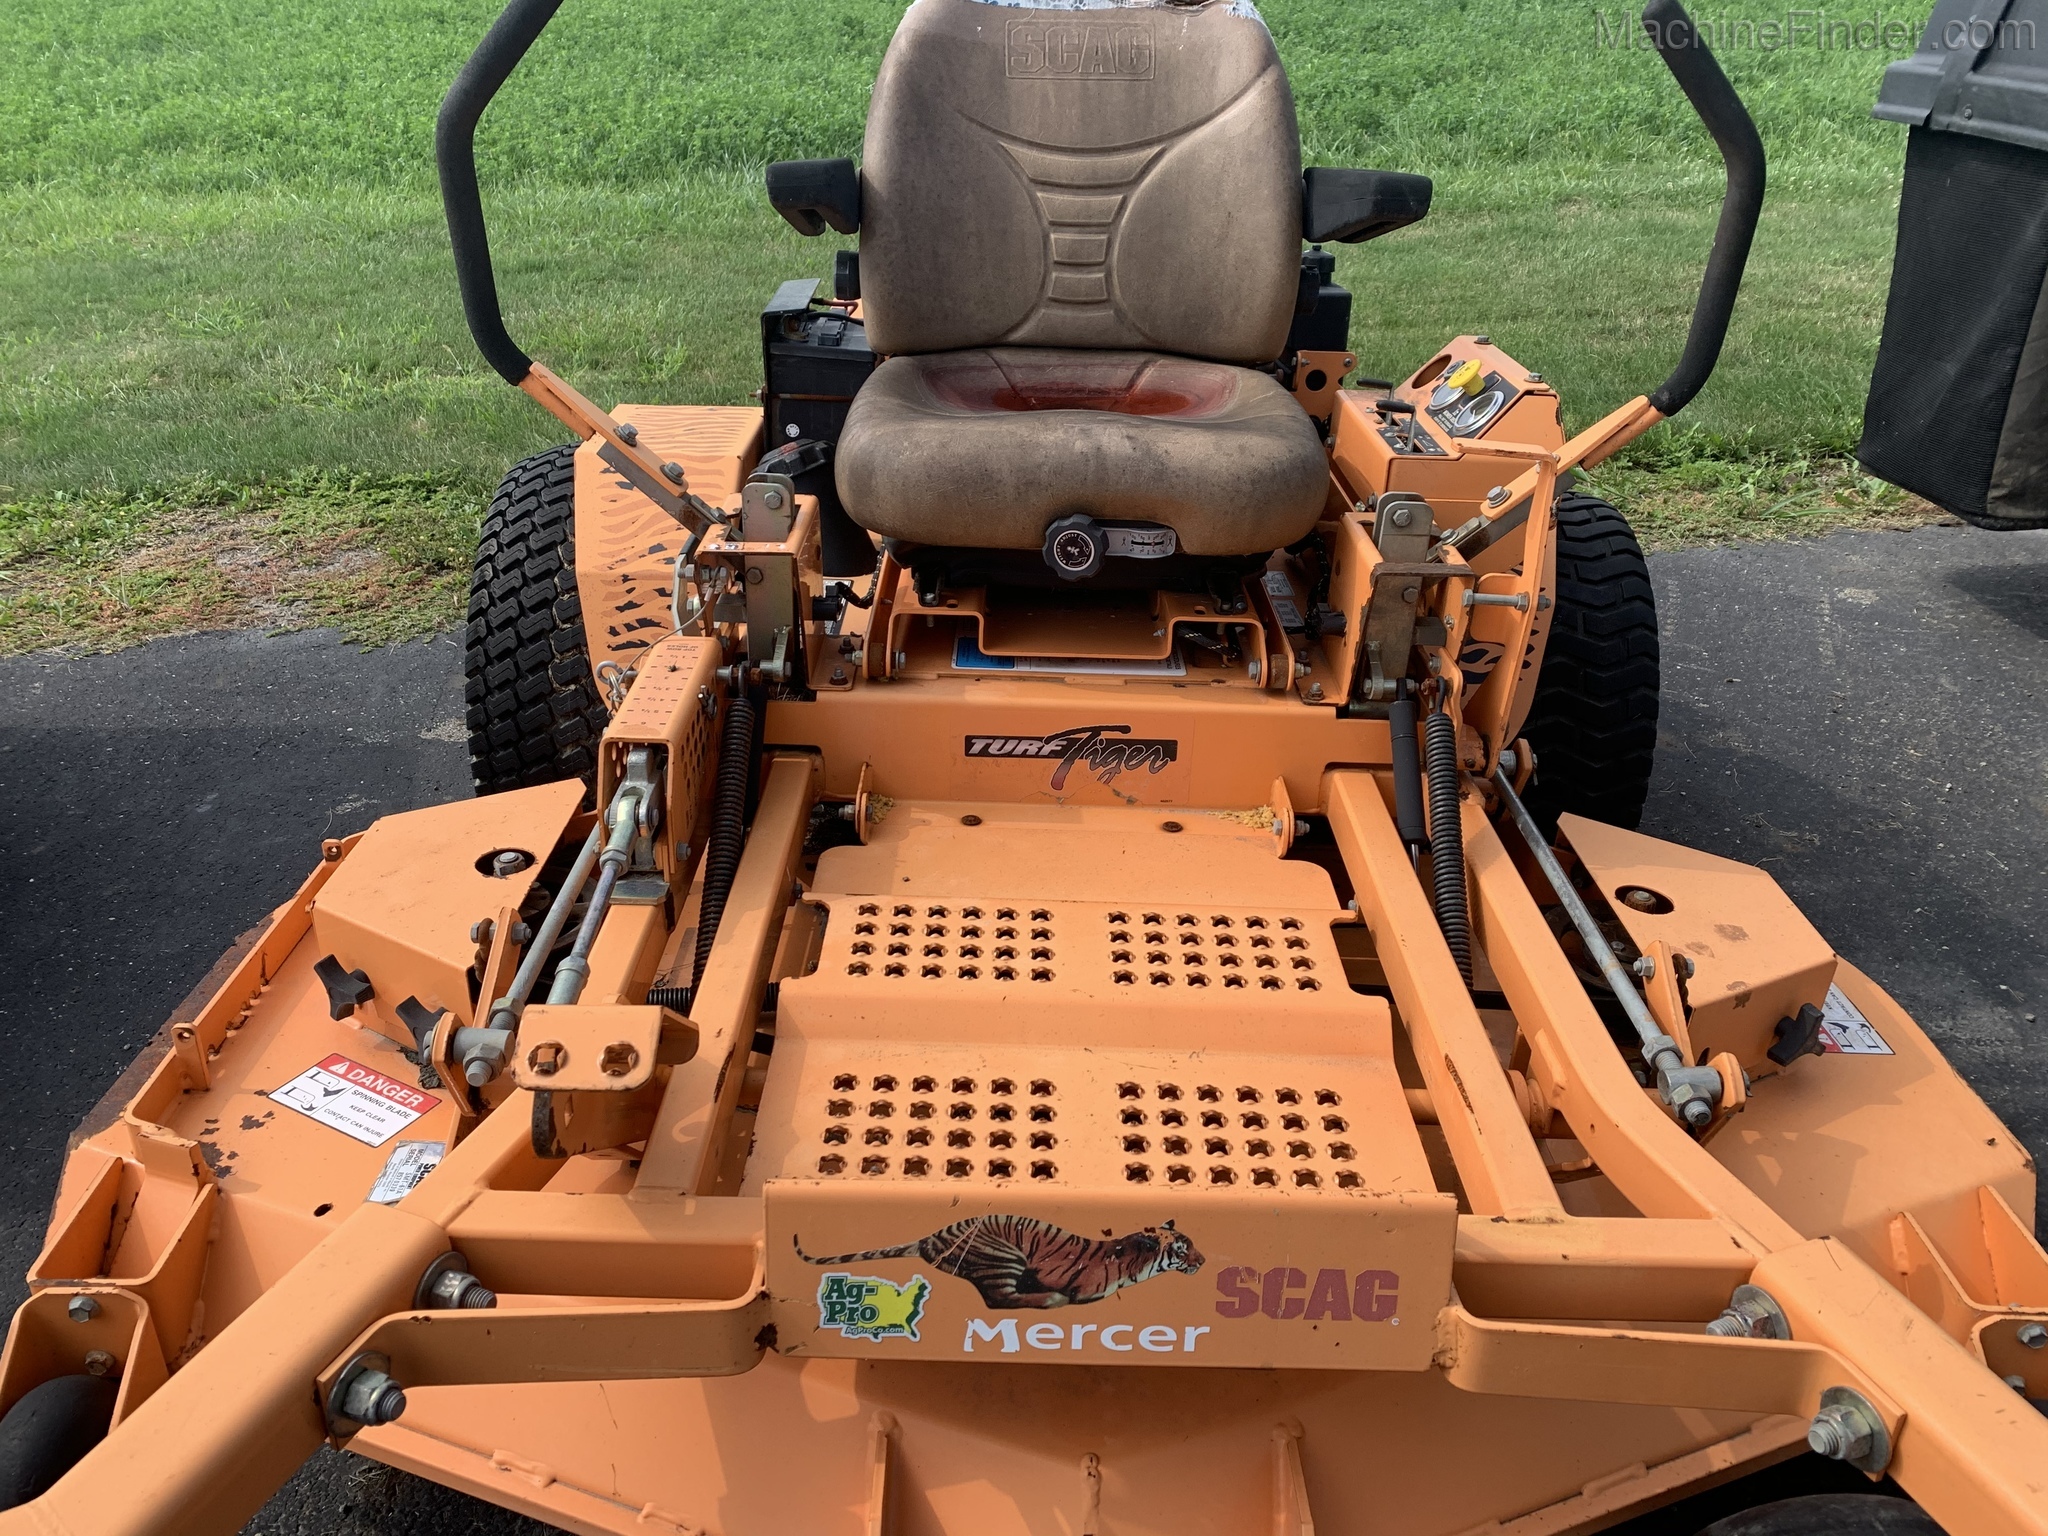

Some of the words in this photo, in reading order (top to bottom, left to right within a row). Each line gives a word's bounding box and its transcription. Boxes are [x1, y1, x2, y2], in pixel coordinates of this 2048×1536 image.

[1010, 25, 1151, 75] SCAG
[968, 738, 1068, 757] TURF
[1043, 724, 1171, 791] Tiger
[346, 1068, 425, 1108] DANGER
[349, 1104, 366, 1113] KEEP
[365, 1111, 386, 1123] CLEAR
[351, 1089, 386, 1108] SPINNING
[385, 1104, 412, 1120] BLADE
[323, 1108, 351, 1122] CONTACT
[350, 1120, 364, 1129] CAN
[362, 1126, 385, 1139] INJURE
[402, 1148, 417, 1167] SERIAL
[410, 1148, 425, 1167] MODEL
[823, 1275, 879, 1305] Ag-
[1214, 1266, 1400, 1322] SCAG
[823, 1300, 880, 1326] Pro
[844, 1325, 905, 1336] AgProCo.com
[963, 1317, 1211, 1354] Mercer
